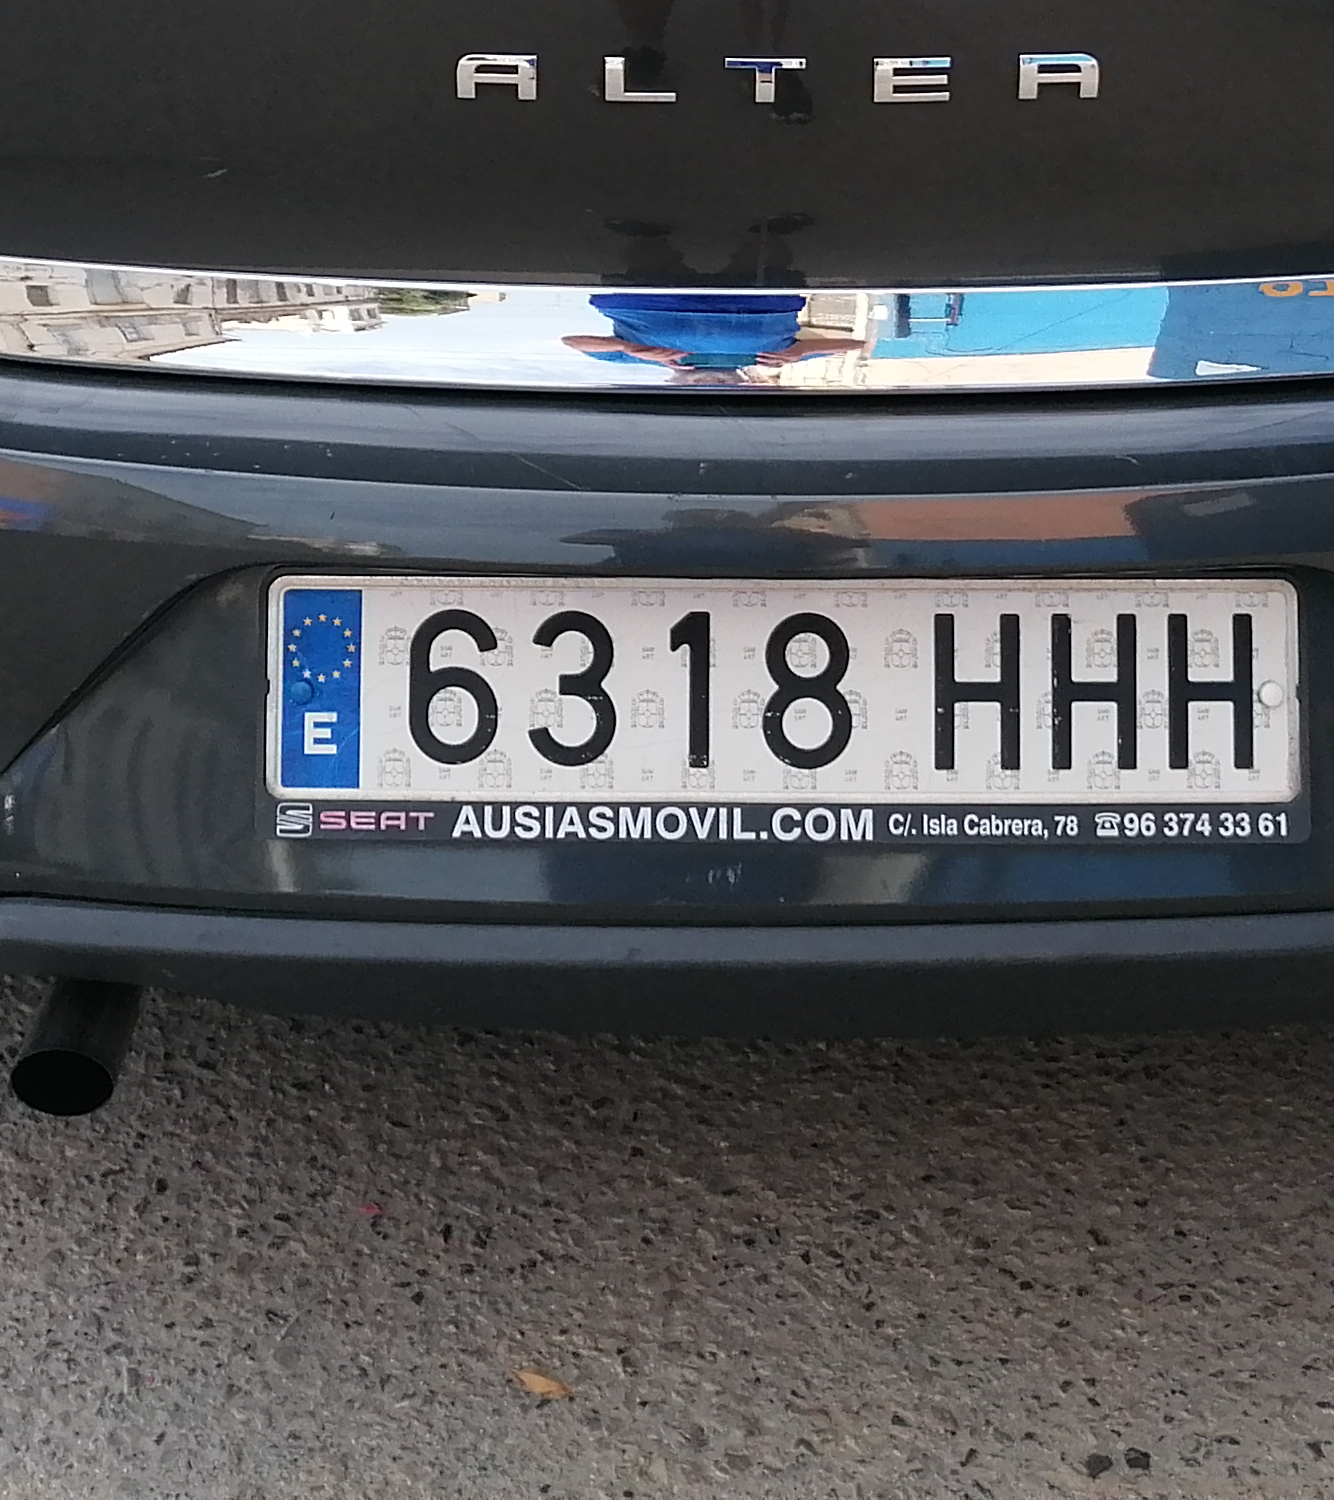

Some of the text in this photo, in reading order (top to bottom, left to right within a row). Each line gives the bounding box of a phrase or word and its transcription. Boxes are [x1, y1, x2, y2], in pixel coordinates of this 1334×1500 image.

[457, 53, 1099, 102] ALTEA
[409, 609, 1253, 770] 6318 HHH
[304, 712, 338, 754] E
[320, 811, 434, 831] SEAT
[452, 805, 874, 841] AUSIASMOVIL.COM
[923, 814, 958, 837] Isla
[965, 814, 1049, 839] Cabrera,
[1054, 815, 1078, 836] 78
[1163, 812, 1211, 837] 374
[1218, 812, 1251, 837] 33
[1258, 812, 1288, 837] 61
